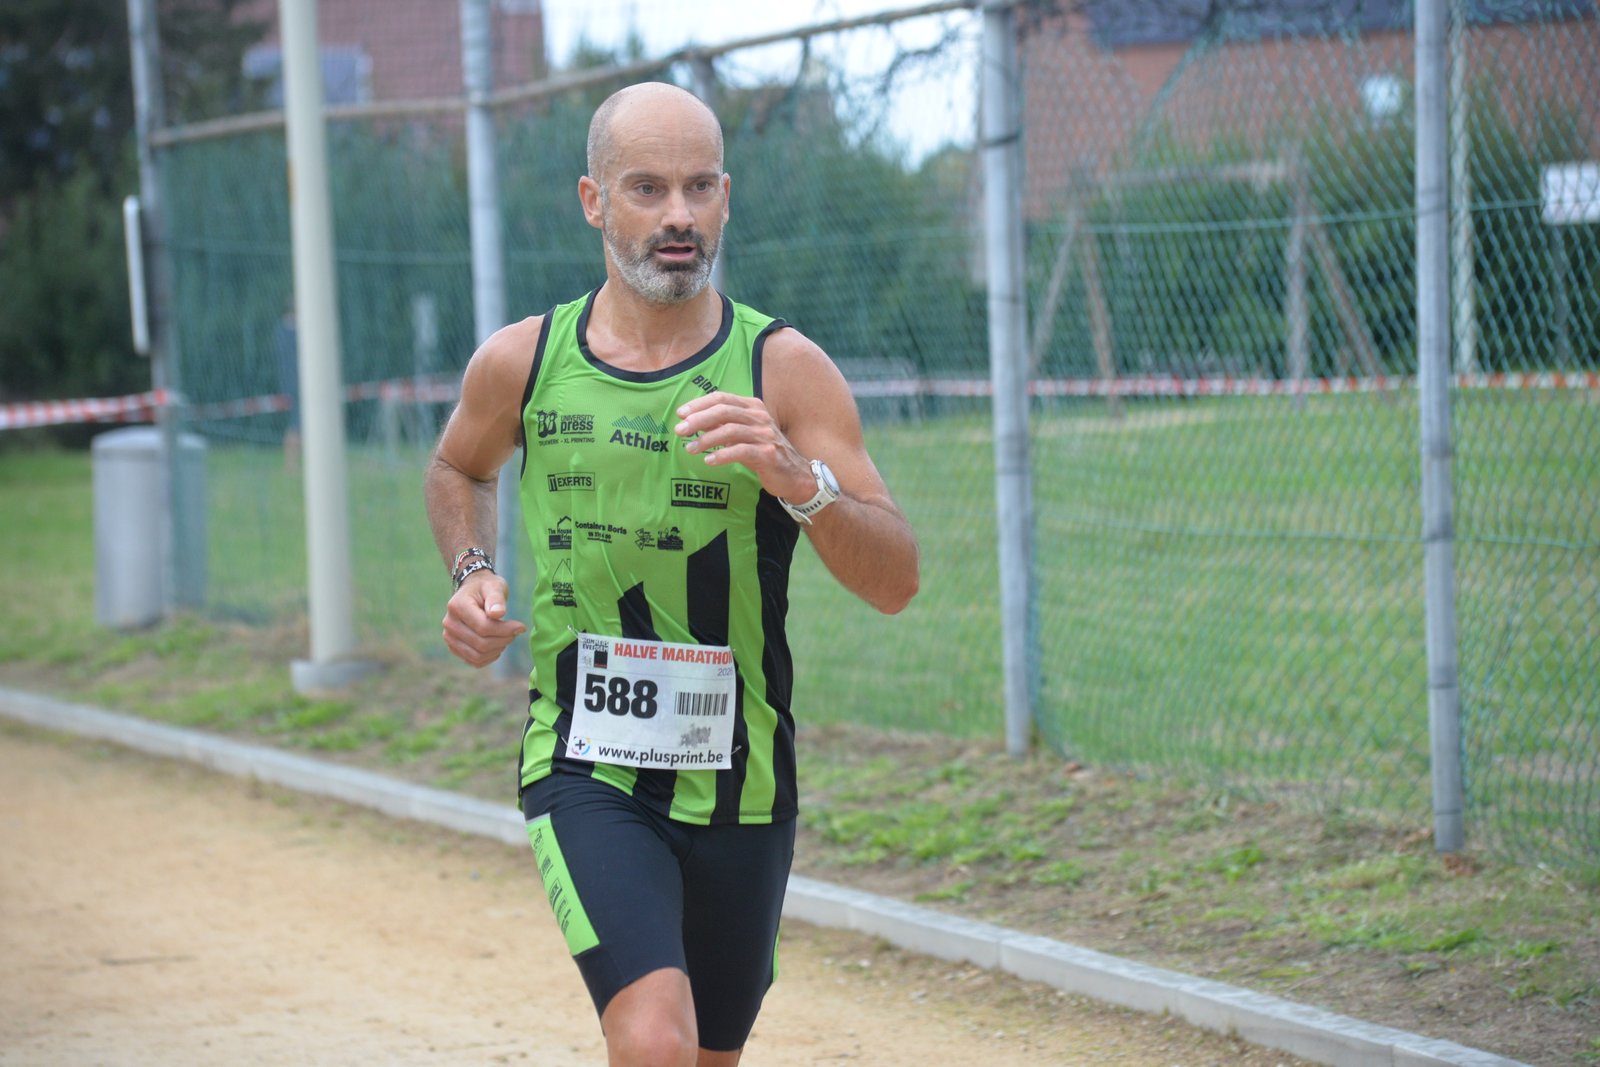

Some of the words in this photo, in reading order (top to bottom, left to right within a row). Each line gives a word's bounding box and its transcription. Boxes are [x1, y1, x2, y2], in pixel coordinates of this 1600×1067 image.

[561, 421, 593, 434] press
[609, 429, 669, 453] Athlex
[674, 483, 725, 500] FIESIEK
[614, 642, 659, 660] HALVE
[584, 673, 659, 719] 588
[598, 746, 724, 767] www.plusprint.be
